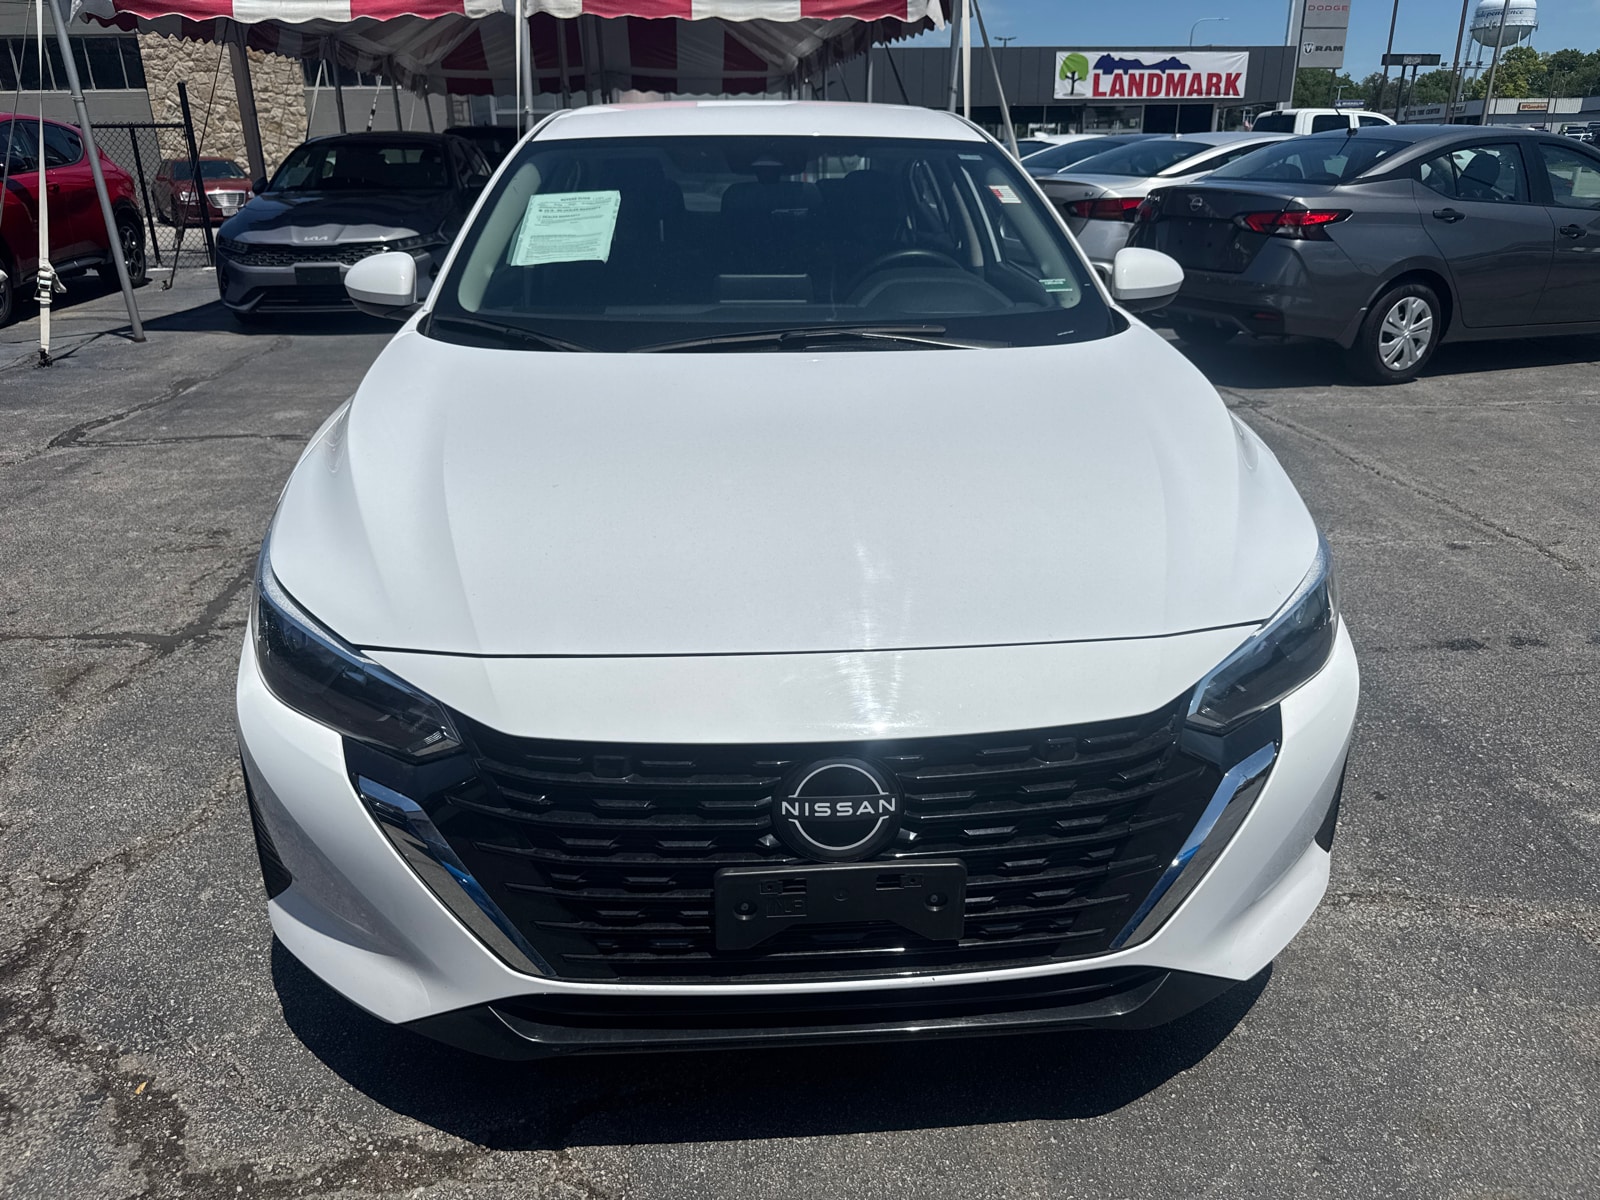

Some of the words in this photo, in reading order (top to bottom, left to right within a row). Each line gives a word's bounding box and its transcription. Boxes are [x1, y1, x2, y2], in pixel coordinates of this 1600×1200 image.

[1475, 9, 1524, 18] depenence
[1092, 73, 1242, 97] LANDMARK
[781, 798, 896, 817] NISSAN
